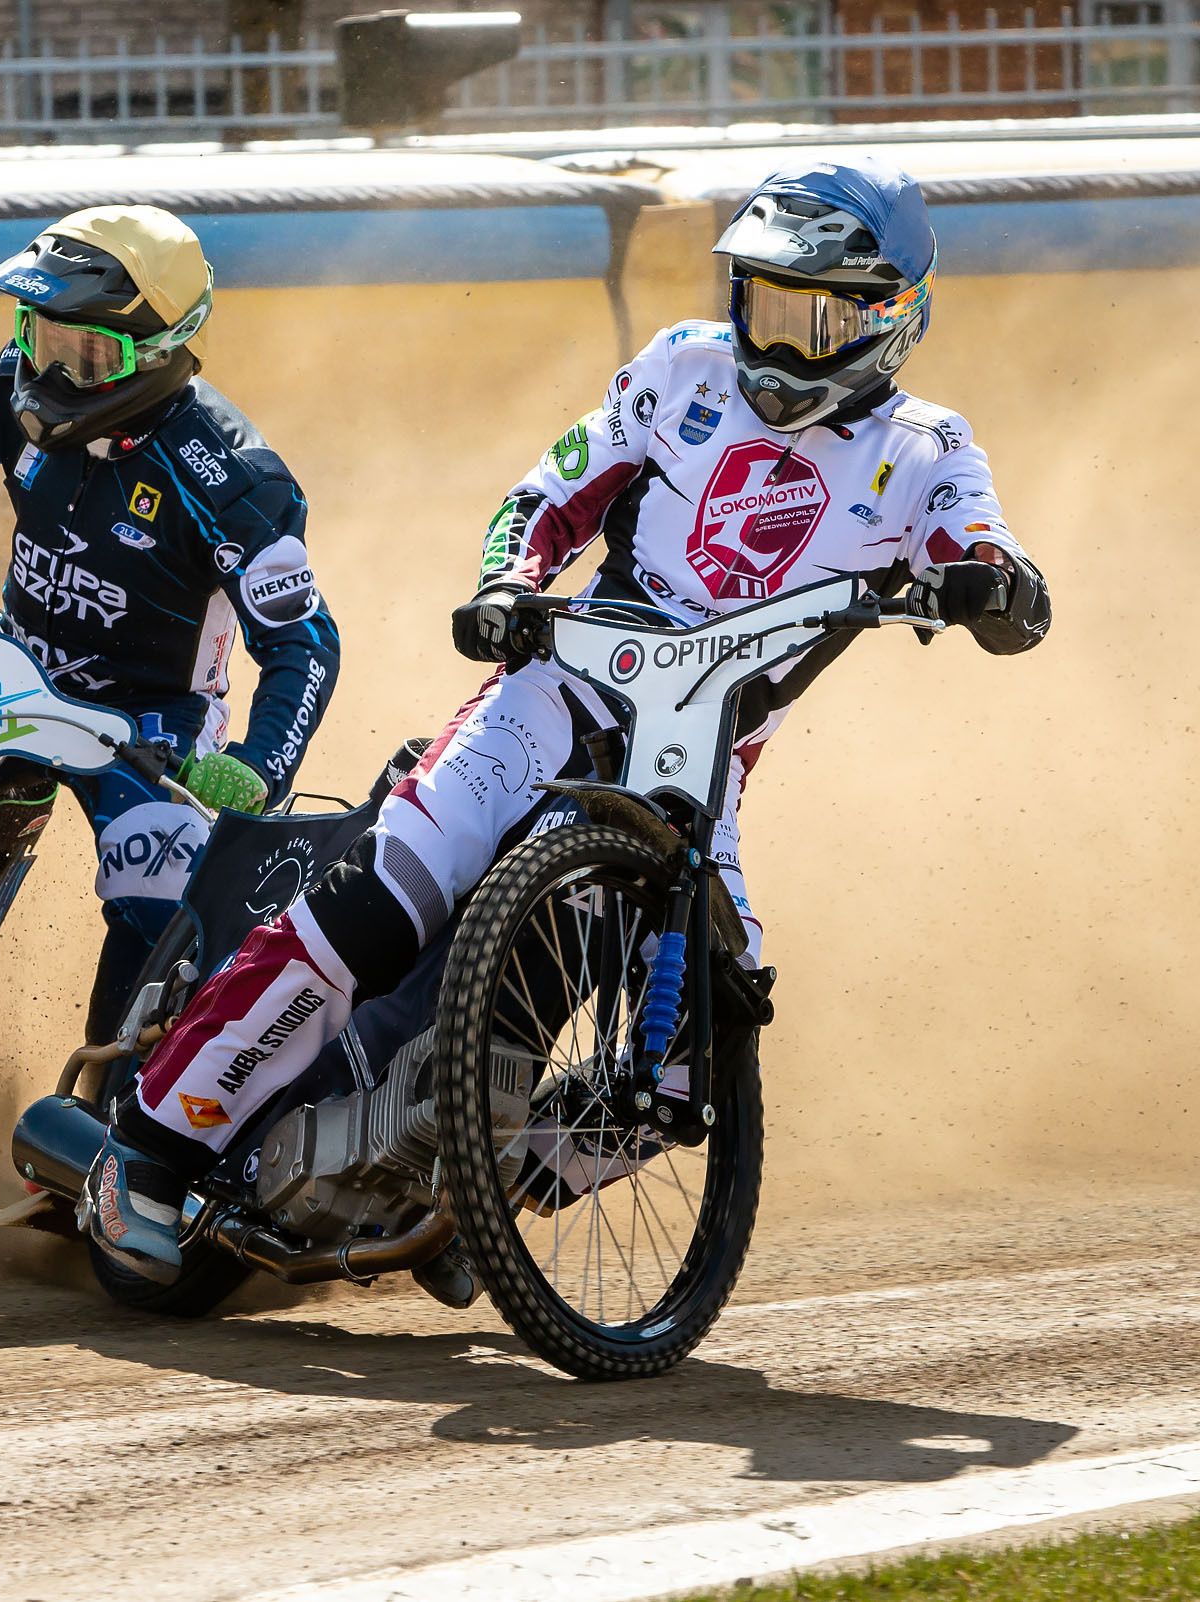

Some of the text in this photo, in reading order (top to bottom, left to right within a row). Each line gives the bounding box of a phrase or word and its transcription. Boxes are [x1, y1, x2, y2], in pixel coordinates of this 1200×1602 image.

[883, 322, 922, 368] Ara
[607, 397, 628, 447] PTIBET
[709, 483, 817, 518] LOKOMOTIV
[758, 508, 817, 525] DAUGAVPILS
[755, 518, 811, 533] SPEEDWAY CLUB
[252, 568, 314, 600] HEKTO
[653, 632, 769, 669] OPTIBET
[499, 714, 538, 750] BEACH
[454, 755, 469, 768] BAR
[474, 775, 489, 792] PUB
[257, 848, 280, 875] THE
[286, 837, 314, 856] BEACH
[257, 987, 326, 1049] STUDIOS
